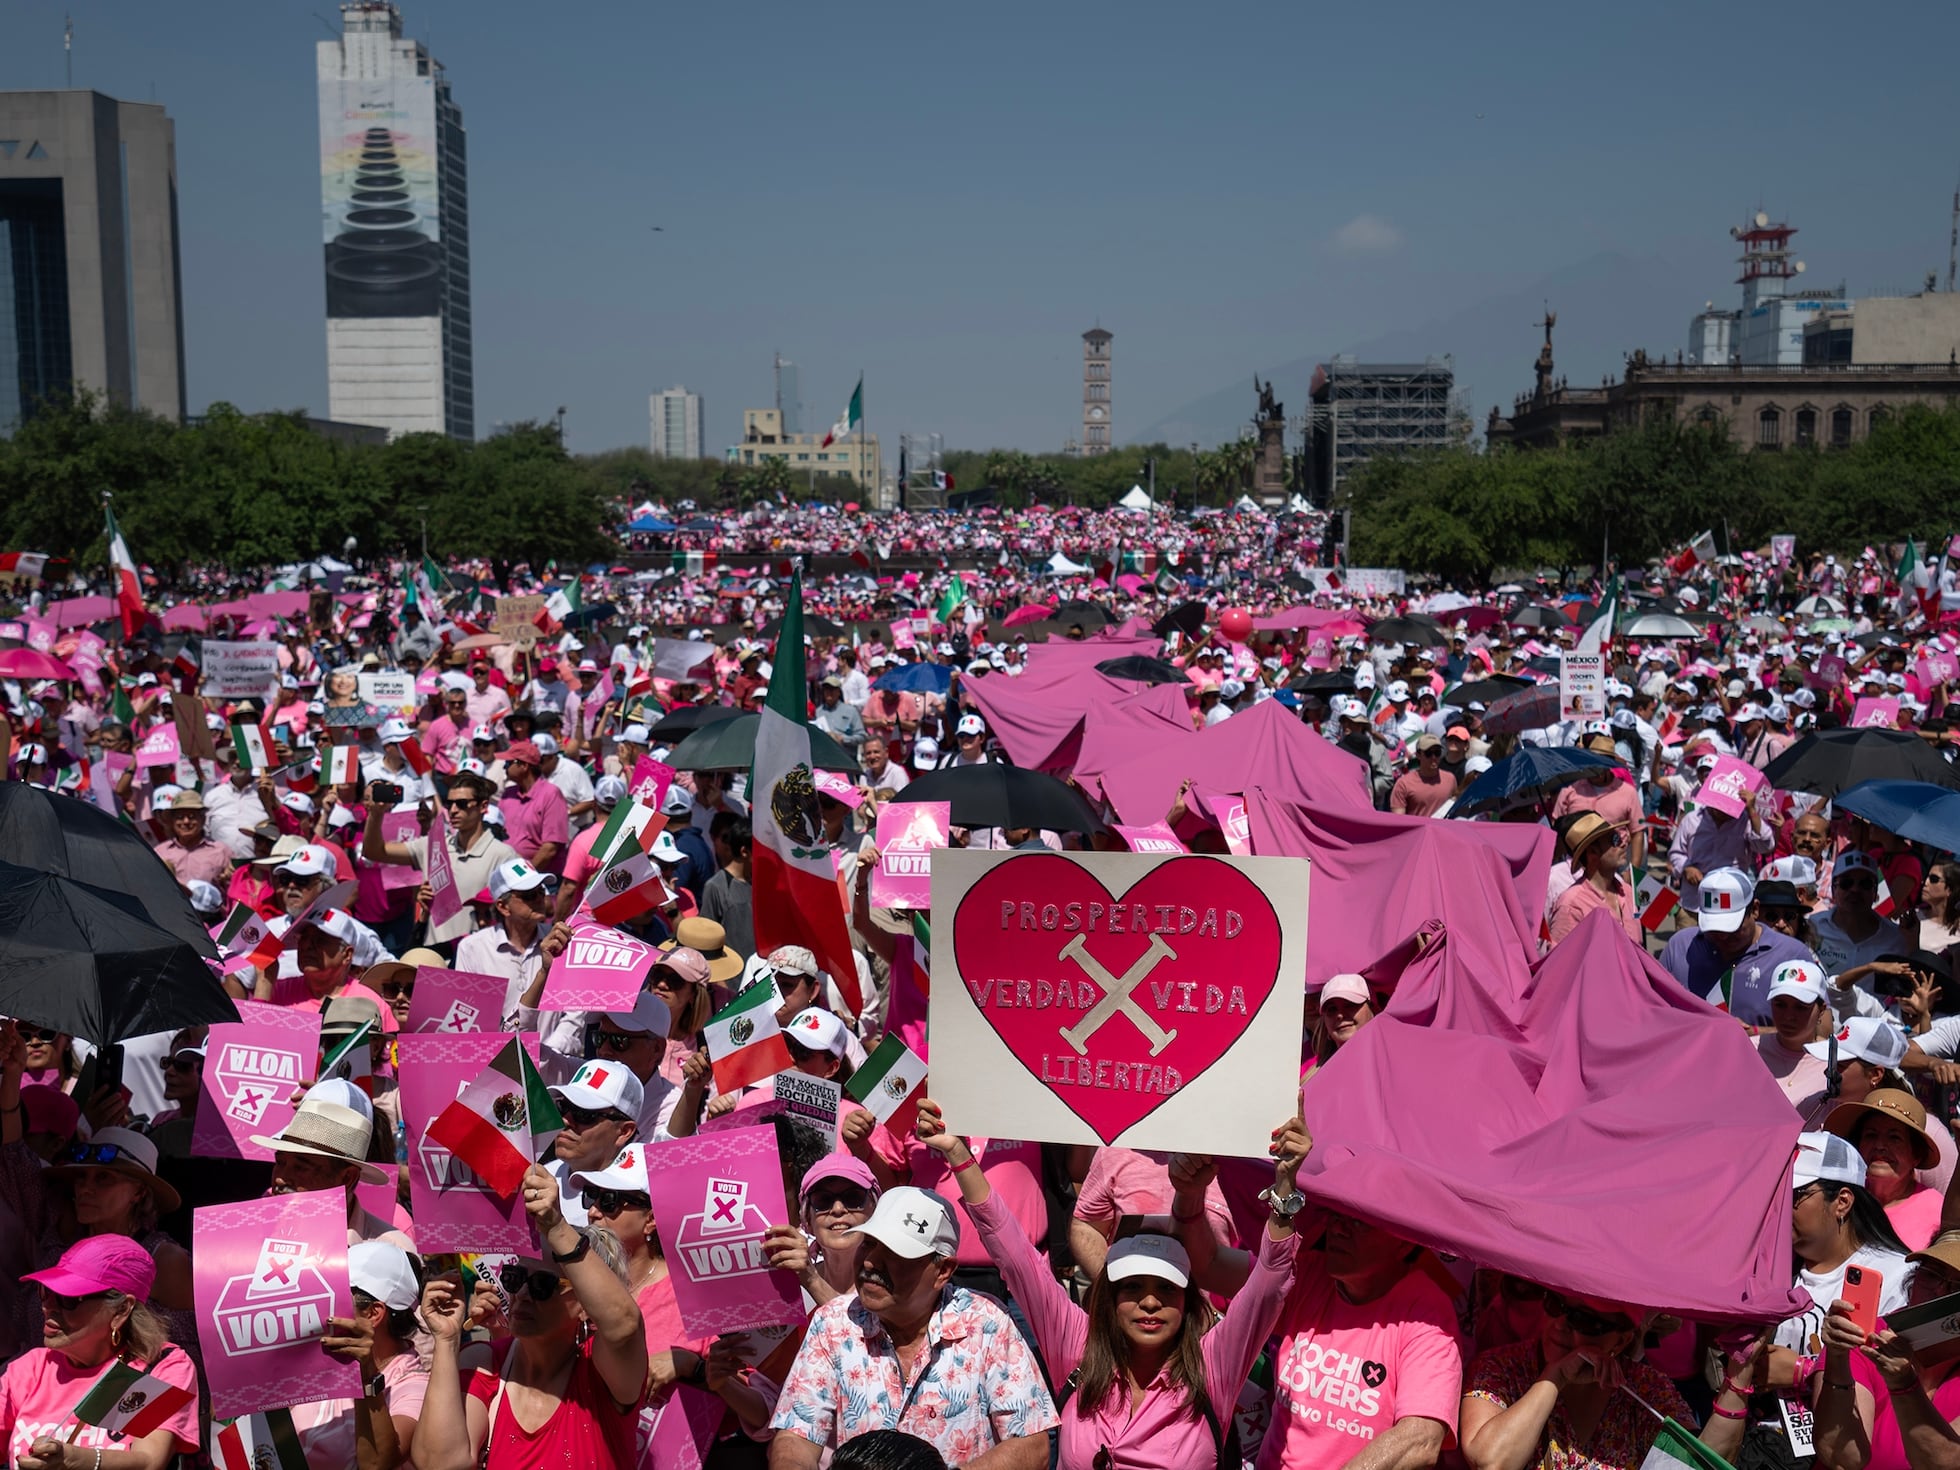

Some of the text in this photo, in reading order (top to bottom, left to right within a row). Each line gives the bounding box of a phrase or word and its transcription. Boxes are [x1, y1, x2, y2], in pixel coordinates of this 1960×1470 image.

[1566, 655, 1599, 664] MÉXICO
[888, 856, 930, 873] VOTA
[1001, 900, 1244, 939] PROSPERIDAD
[573, 942, 633, 967] VOTA
[970, 979, 1096, 1009] VERDAD
[1150, 981, 1248, 1016] VIDA
[230, 1048, 294, 1079] VOTA
[1041, 1054, 1183, 1095] LIBERTAD
[776, 1074, 837, 1097] CON XÓCHITL
[791, 1084, 837, 1102] PROGRAMAS
[776, 1087, 837, 1112] SOCIALES
[791, 1101, 835, 1123] QUEDAN
[717, 1183, 738, 1194] VOTA
[273, 1243, 296, 1254] VOTA
[688, 1240, 771, 1275] VOTA
[228, 1303, 324, 1349] VOTA
[722, 1324, 748, 1333] CONSERVA
[761, 1319, 780, 1327] POSTER
[1280, 1358, 1381, 1417] LOVERS
[257, 1393, 329, 1411] CONSERVA ESTE POSTER
[1326, 1410, 1375, 1440] León
